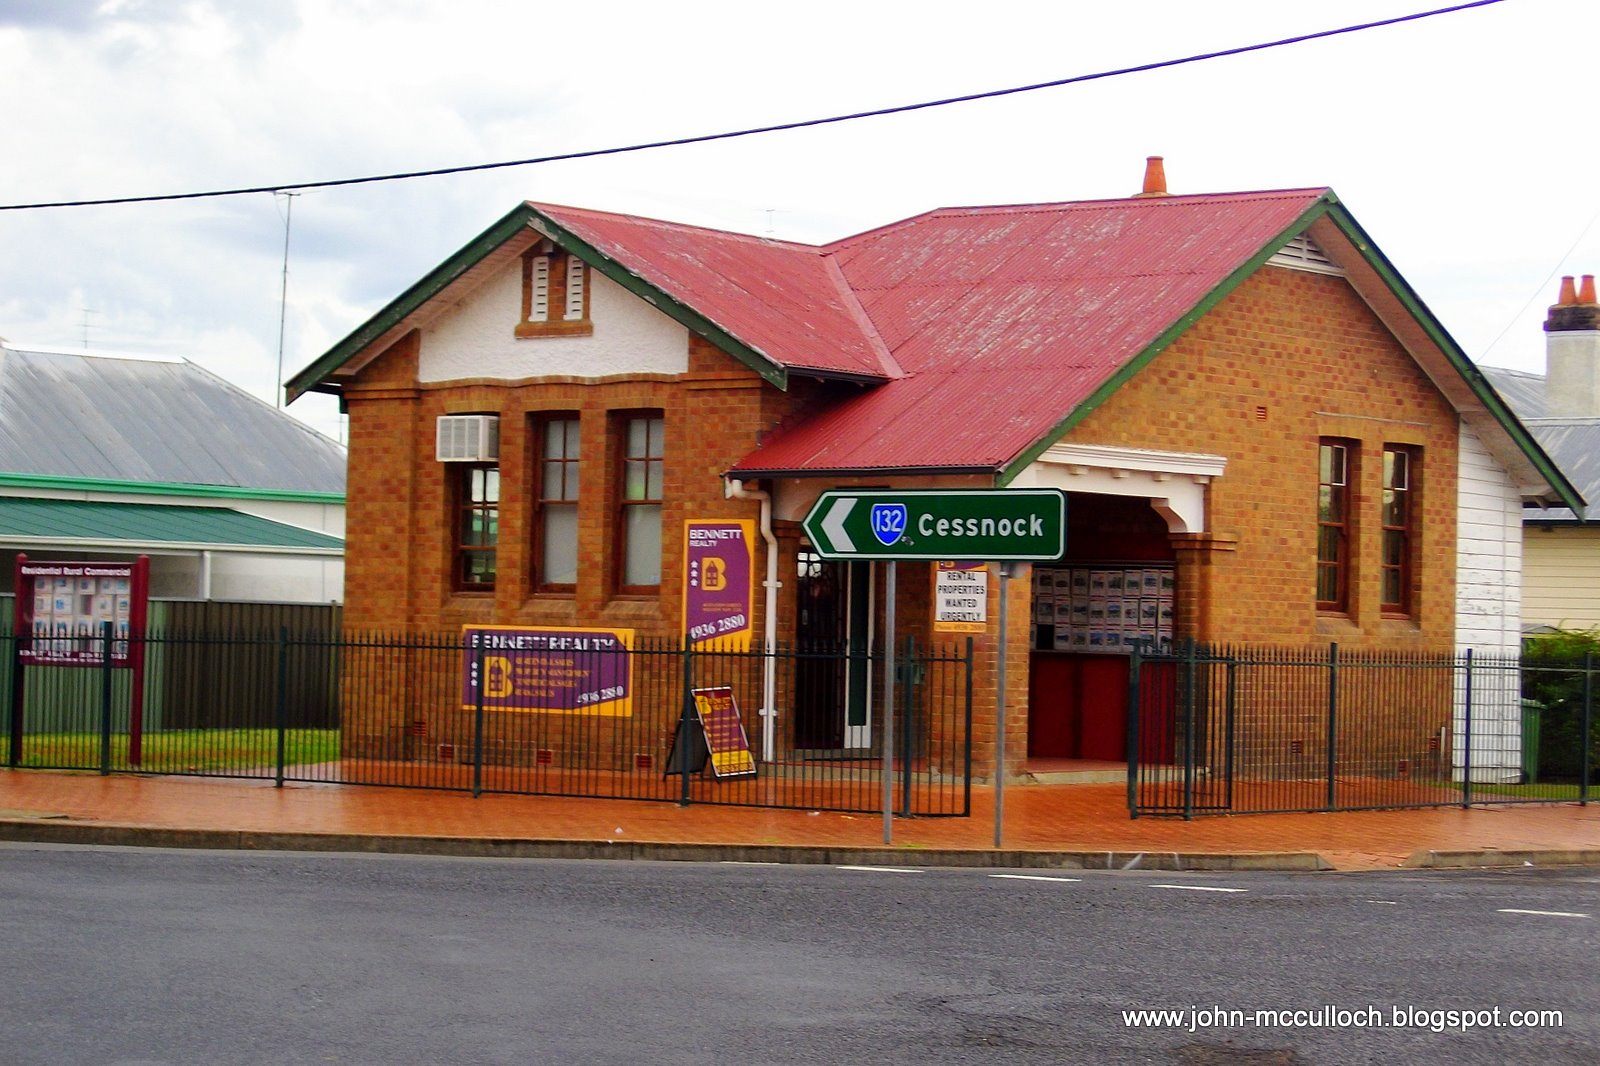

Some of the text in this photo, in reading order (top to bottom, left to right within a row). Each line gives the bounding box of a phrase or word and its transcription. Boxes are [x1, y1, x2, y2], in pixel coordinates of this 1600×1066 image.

[875, 509, 1044, 537] 132 Cessnock
[689, 529, 743, 540] BENNETT
[84, 568, 131, 577] Commercial
[946, 571, 976, 581] RENTAL
[938, 585, 985, 594] PROPERTIES
[945, 598, 978, 608] WANTED
[940, 611, 981, 621] URGENTLY
[718, 614, 746, 632] 2880
